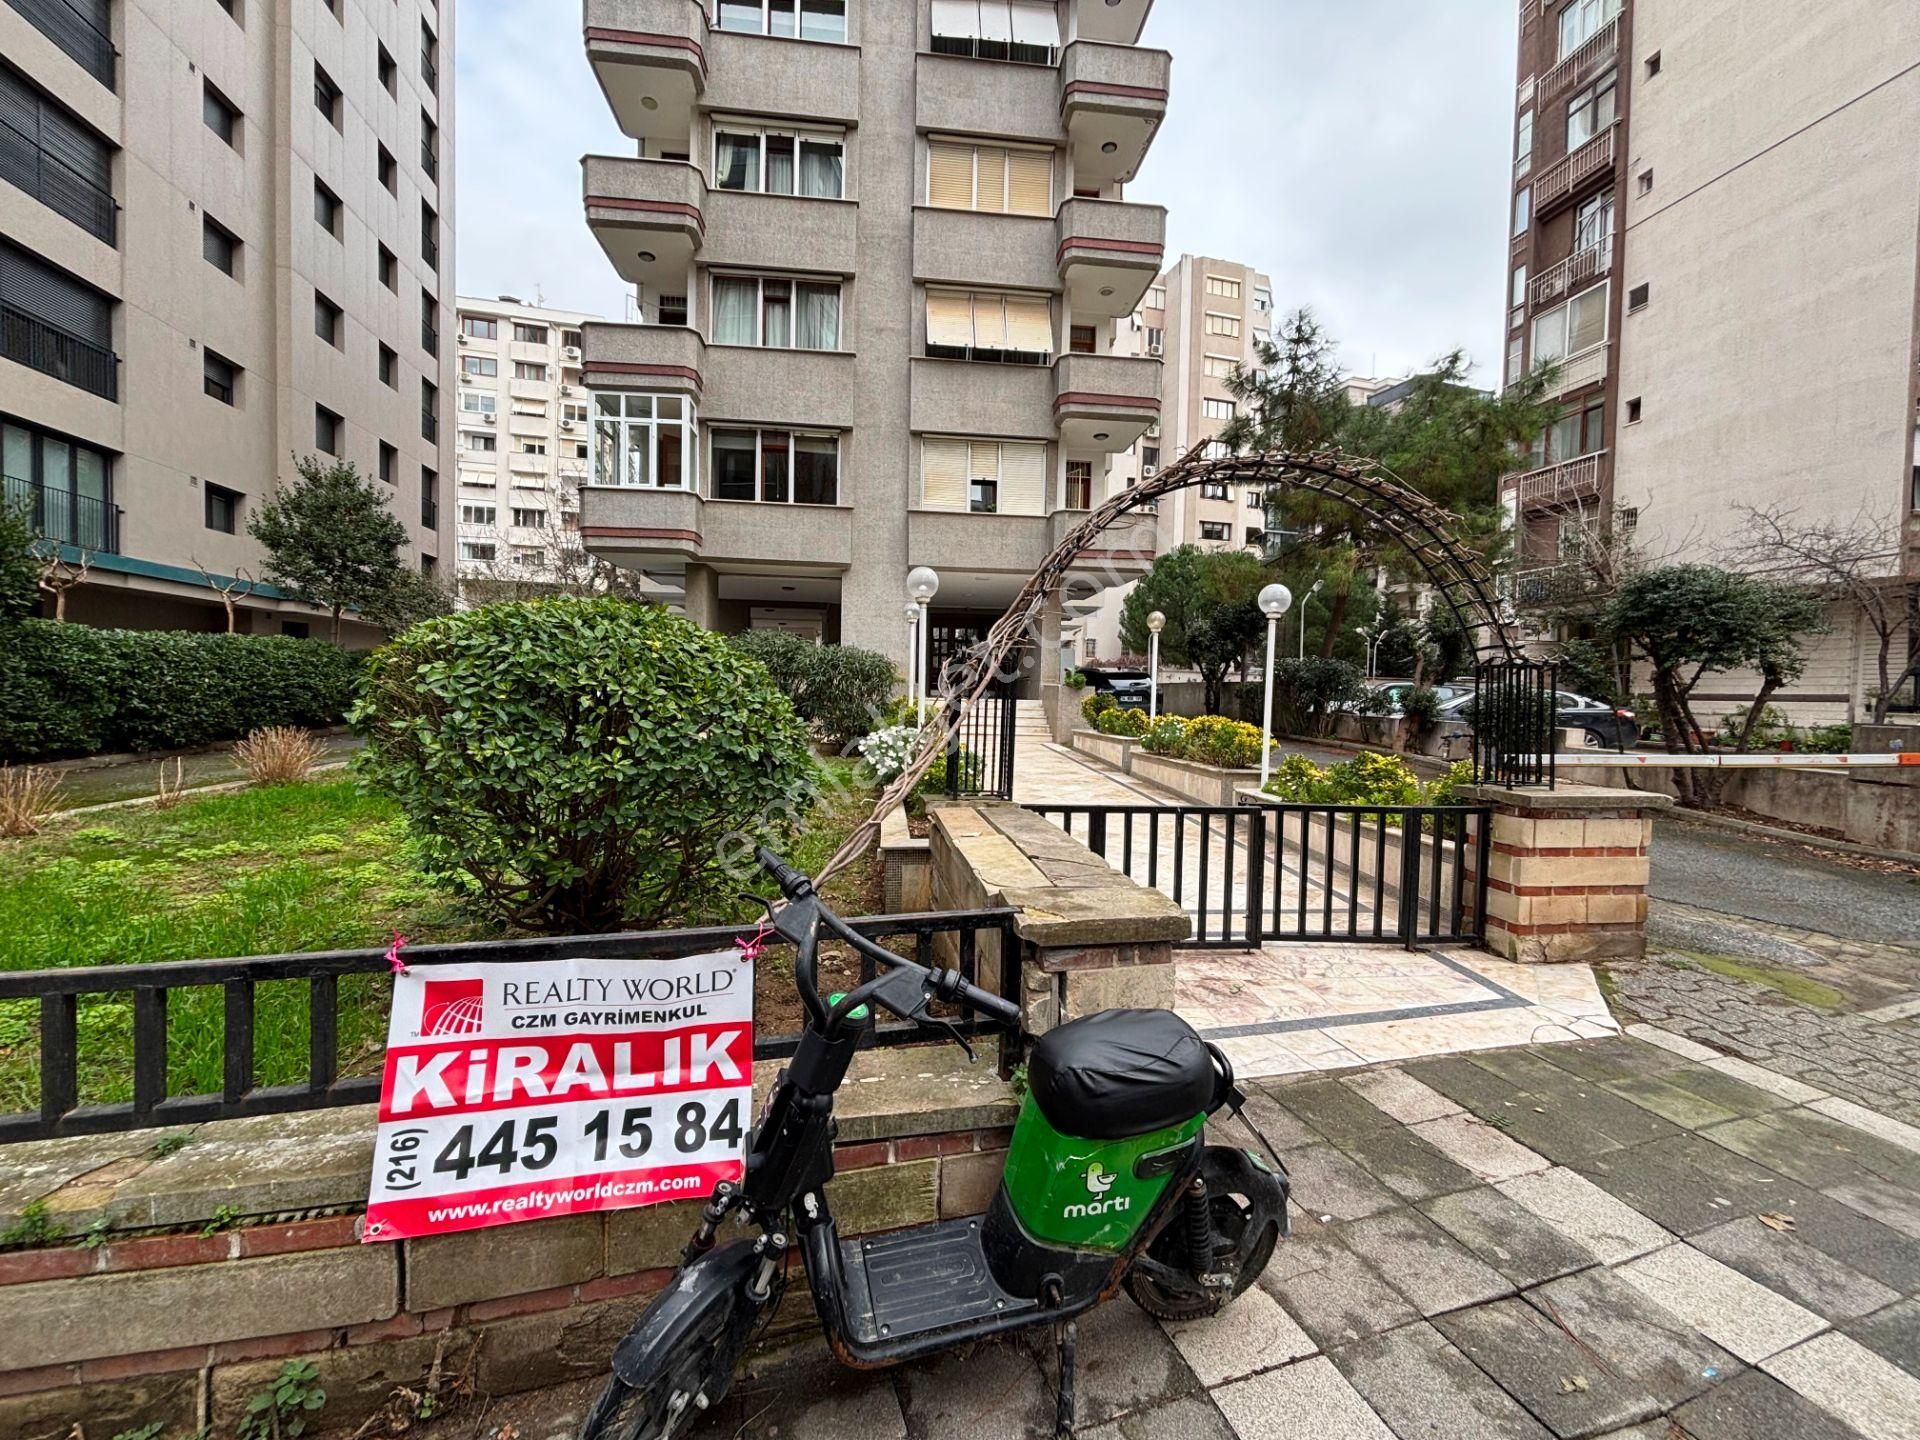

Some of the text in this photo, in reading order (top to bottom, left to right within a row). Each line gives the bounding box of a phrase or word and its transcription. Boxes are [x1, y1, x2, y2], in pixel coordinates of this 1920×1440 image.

[502, 969, 734, 1006] REALTY WORLD
[511, 1004, 708, 1029] CZM GAYRİMENKUL
[384, 1098, 743, 1191] (216) 445 15 84
[427, 1174, 701, 1223] www.realtyworldczm.com
